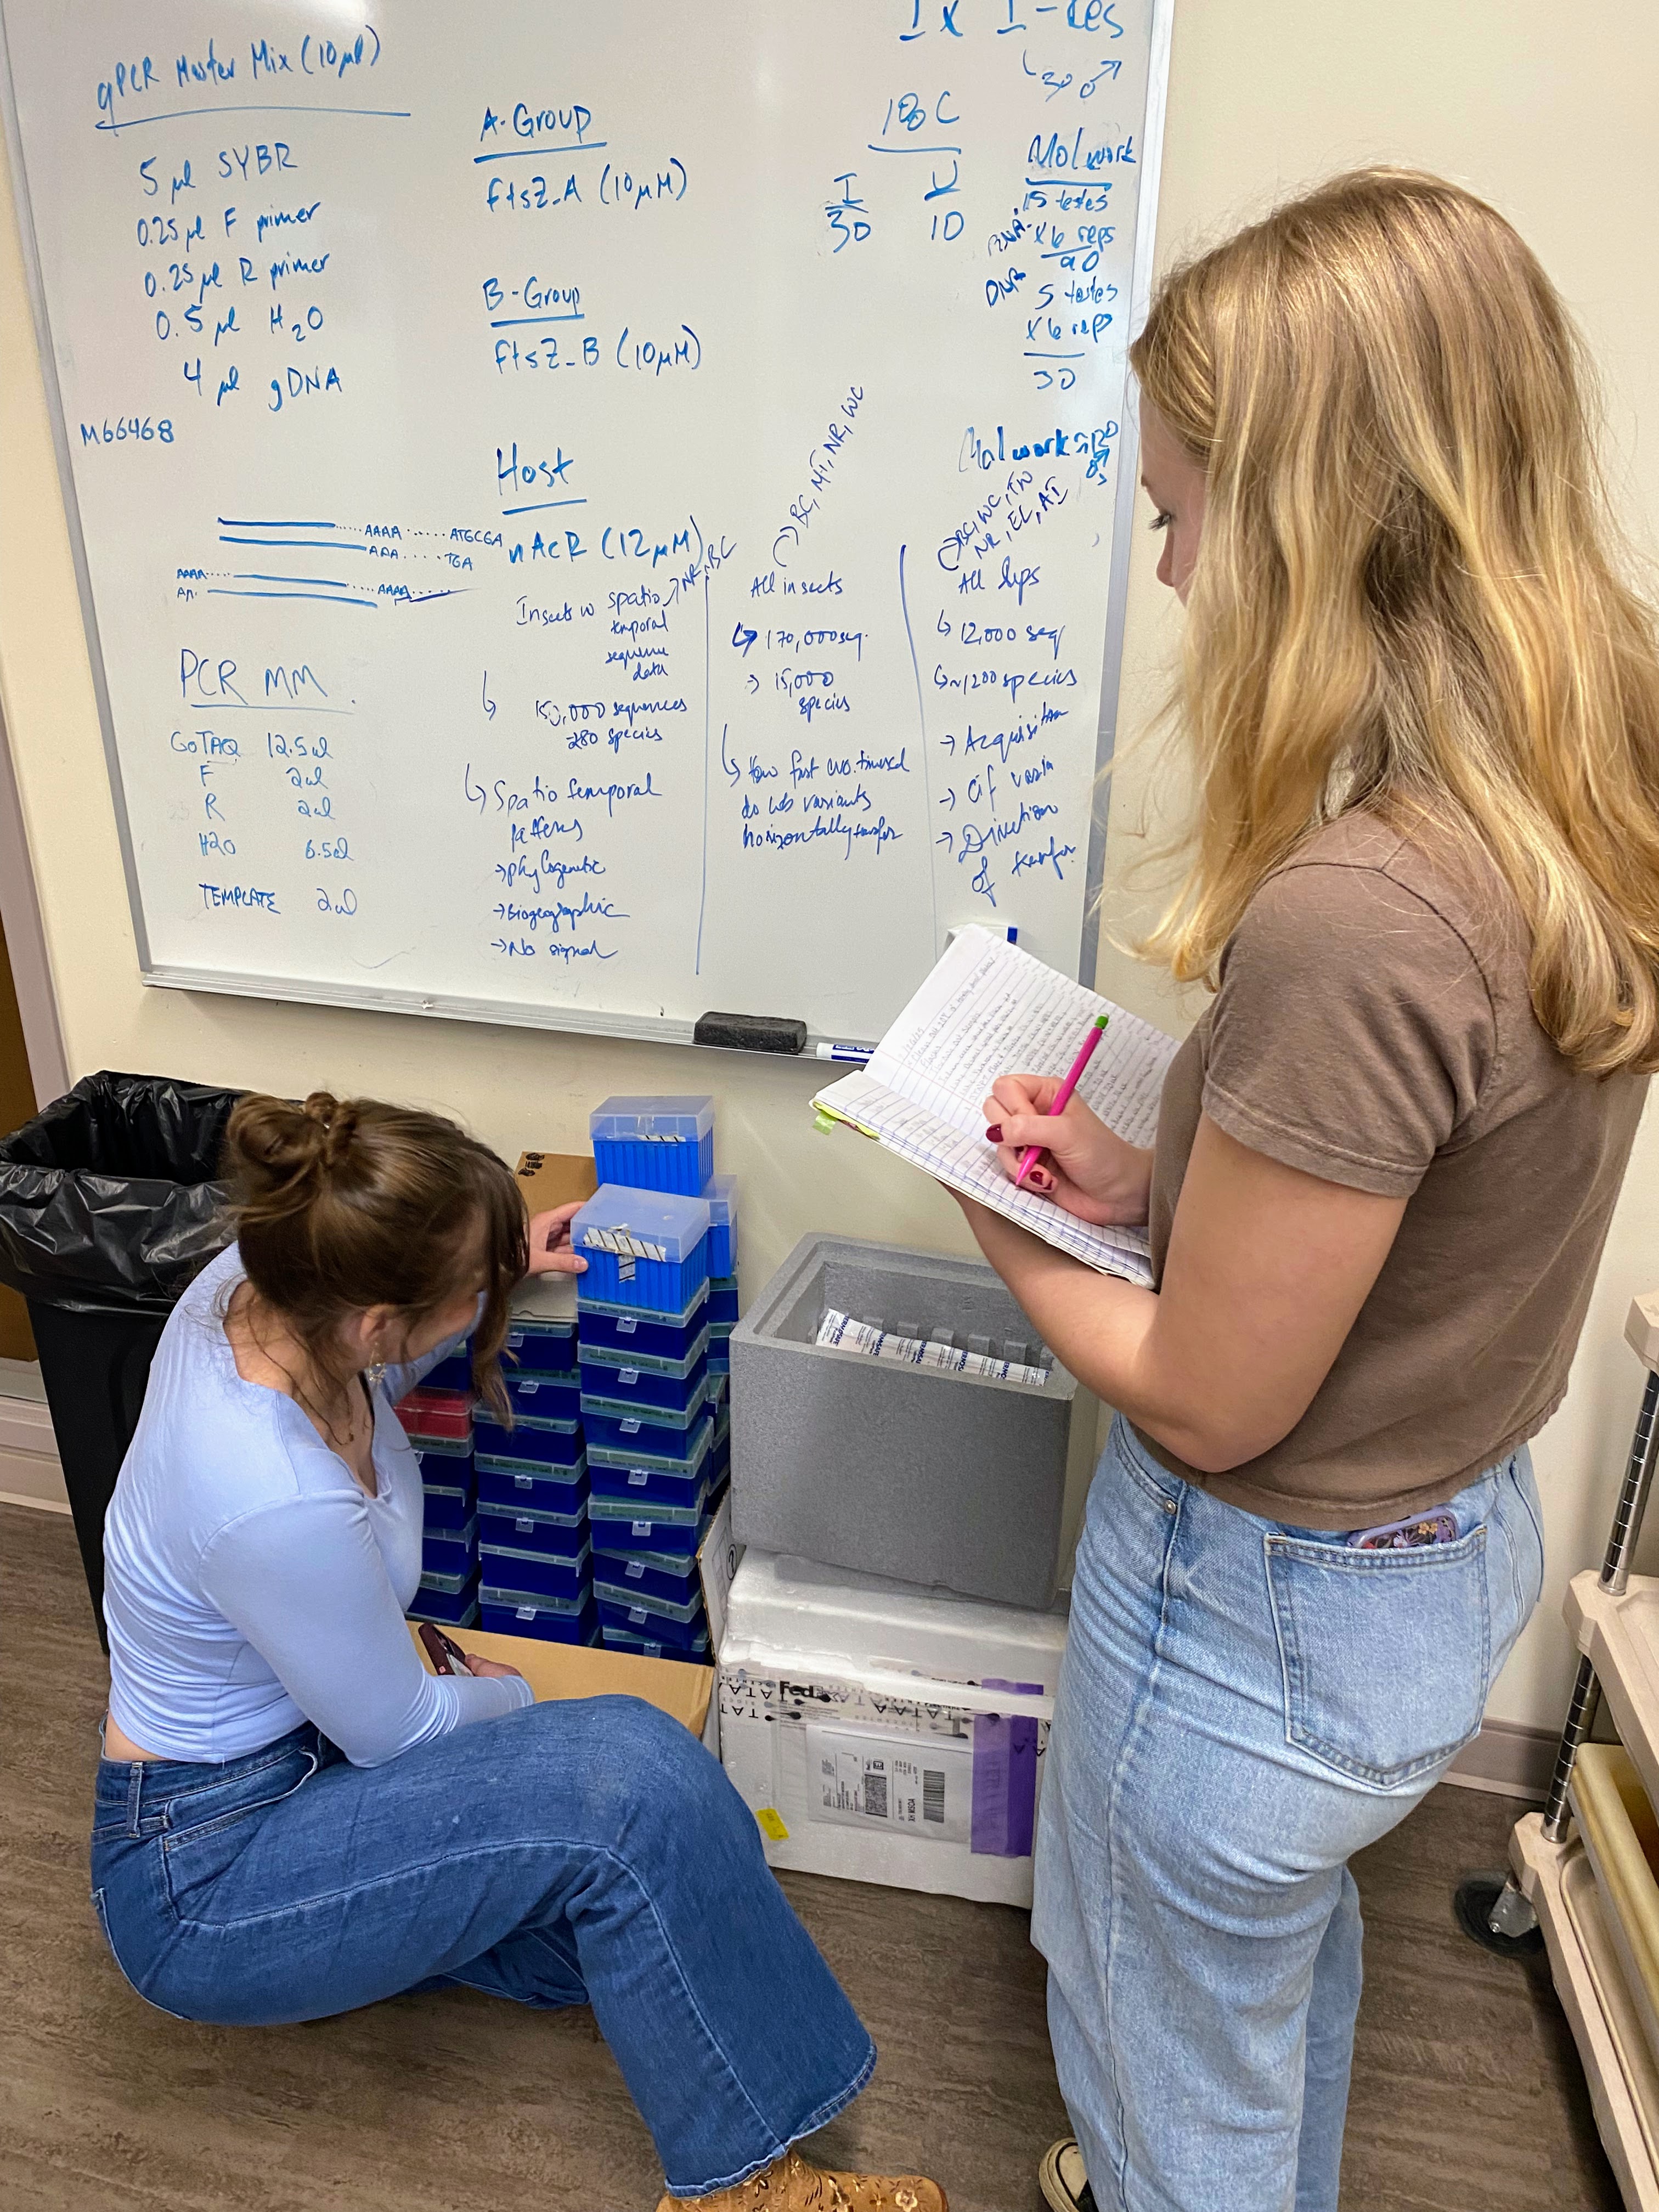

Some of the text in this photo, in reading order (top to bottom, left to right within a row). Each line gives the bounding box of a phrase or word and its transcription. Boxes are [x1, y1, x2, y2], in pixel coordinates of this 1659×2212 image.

[98, 57, 160, 136] qPCR
[177, 38, 234, 87] Master
[251, 38, 292, 80] Mix
[140, 156, 157, 195] 5
[219, 143, 297, 180] SYBR
[137, 216, 178, 246] 0.25
[224, 207, 236, 237] F
[257, 201, 321, 242] primer
[826, 211, 871, 253] 30
[932, 211, 964, 241] 10
[1078, 225, 1116, 252] reps
[144, 263, 194, 297] 0.25
[239, 258, 258, 286] R
[270, 252, 330, 290] primer
[1035, 284, 1054, 310] 5
[156, 304, 203, 340] 0.5
[184, 358, 202, 396] 4
[269, 366, 342, 412] gDNA
[80, 417, 174, 447] M66468
[1012, 428, 1070, 460] work
[496, 443, 574, 495] Host
[364, 525, 503, 547] AAAA ATGCGA
[445, 553, 473, 571] TGA
[751, 571, 843, 597] All insects
[959, 569, 985, 594] All
[516, 595, 573, 626] Insects
[180, 648, 328, 705] PCR MM
[633, 662, 669, 681] data
[1002, 669, 1077, 703] species
[613, 698, 688, 727] sequences
[799, 693, 850, 723] species
[608, 726, 663, 754] species
[200, 765, 214, 787] F
[790, 749, 819, 789] fast
[205, 793, 225, 821] R
[742, 794, 759, 819] do
[804, 783, 871, 812] variants
[743, 814, 851, 861] horizontally
[972, 856, 996, 907] of
[199, 883, 281, 915] TEMPLATE
[509, 938, 618, 964] No signal
